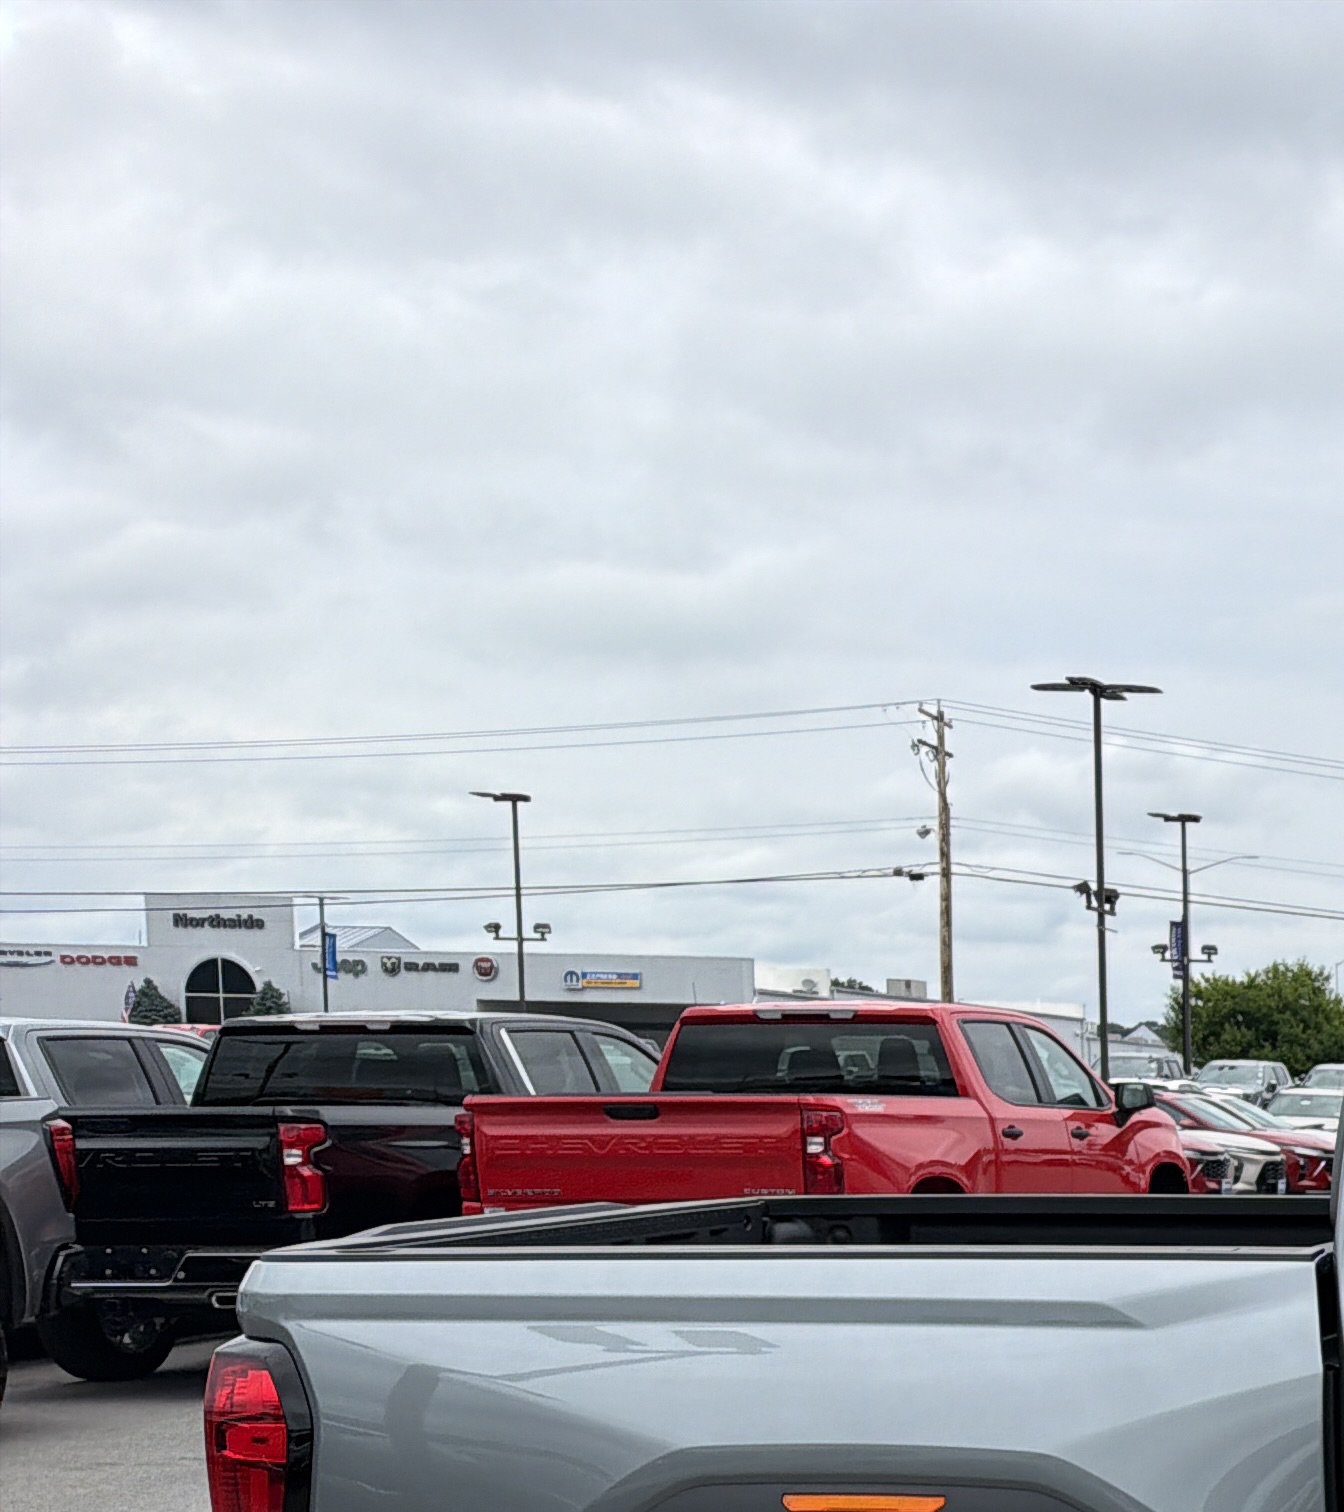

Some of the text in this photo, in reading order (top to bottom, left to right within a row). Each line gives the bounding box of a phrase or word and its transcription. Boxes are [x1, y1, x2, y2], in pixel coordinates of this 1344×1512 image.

[172, 912, 266, 930] Northside
[59, 954, 139, 967] DODGE
[403, 961, 460, 973] RAM
